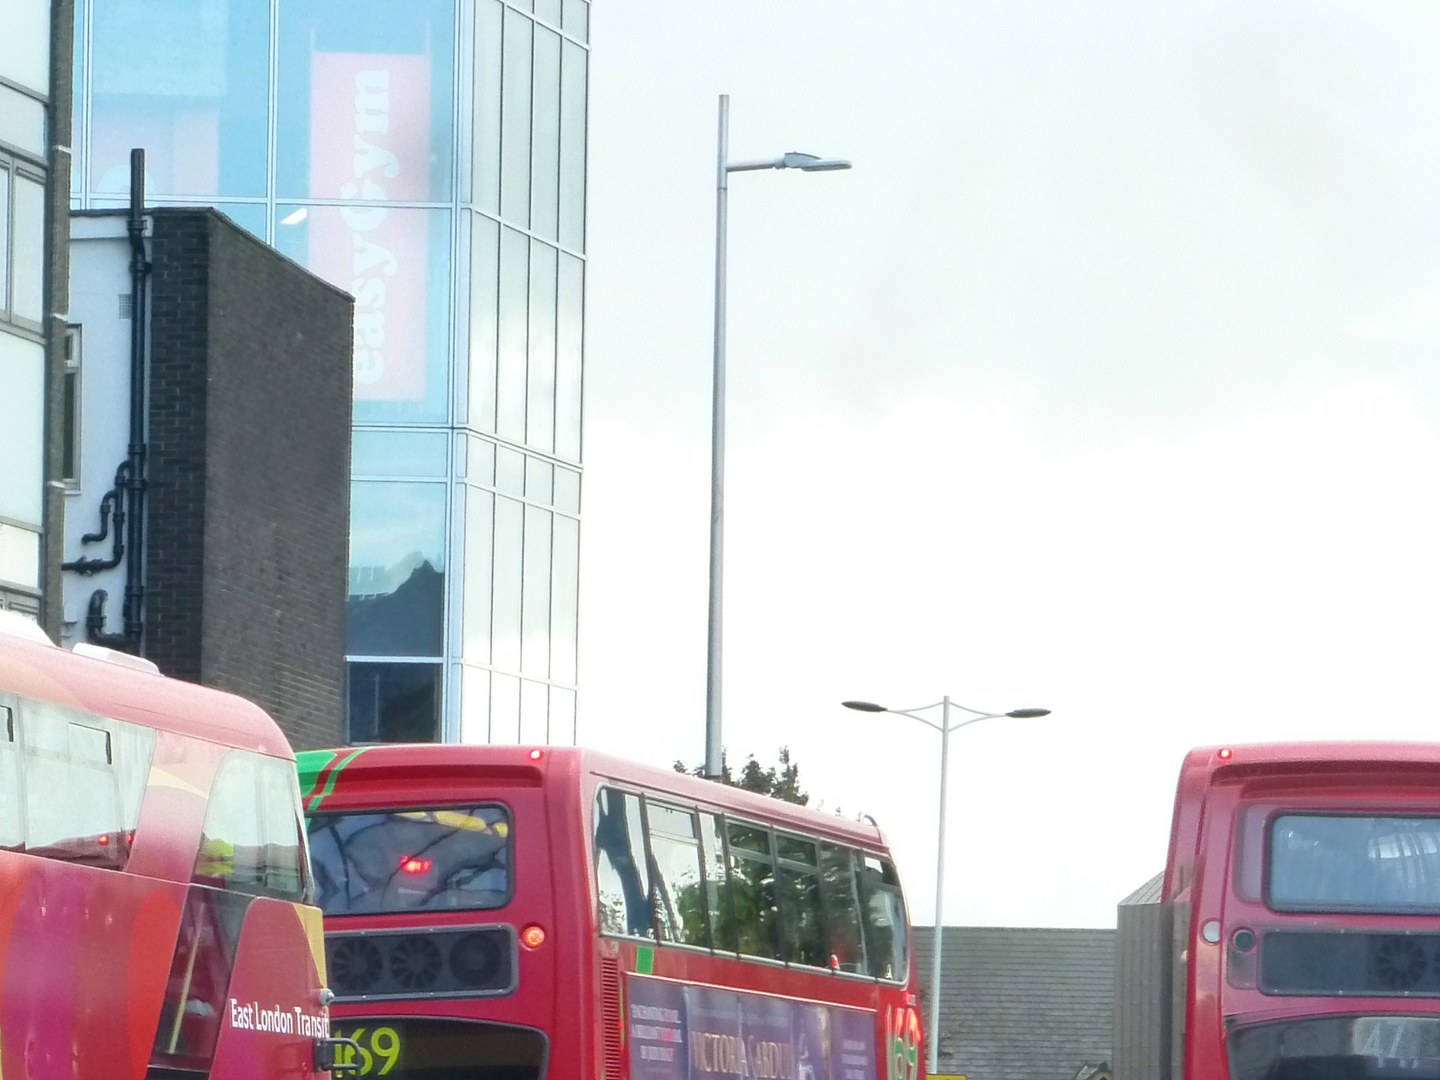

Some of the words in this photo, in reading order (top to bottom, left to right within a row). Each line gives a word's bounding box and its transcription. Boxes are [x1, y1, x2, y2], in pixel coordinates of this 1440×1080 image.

[339, 68, 400, 386] easyGym
[230, 998, 254, 1029] East
[253, 1001, 293, 1034] London
[293, 1006, 330, 1038] Transit
